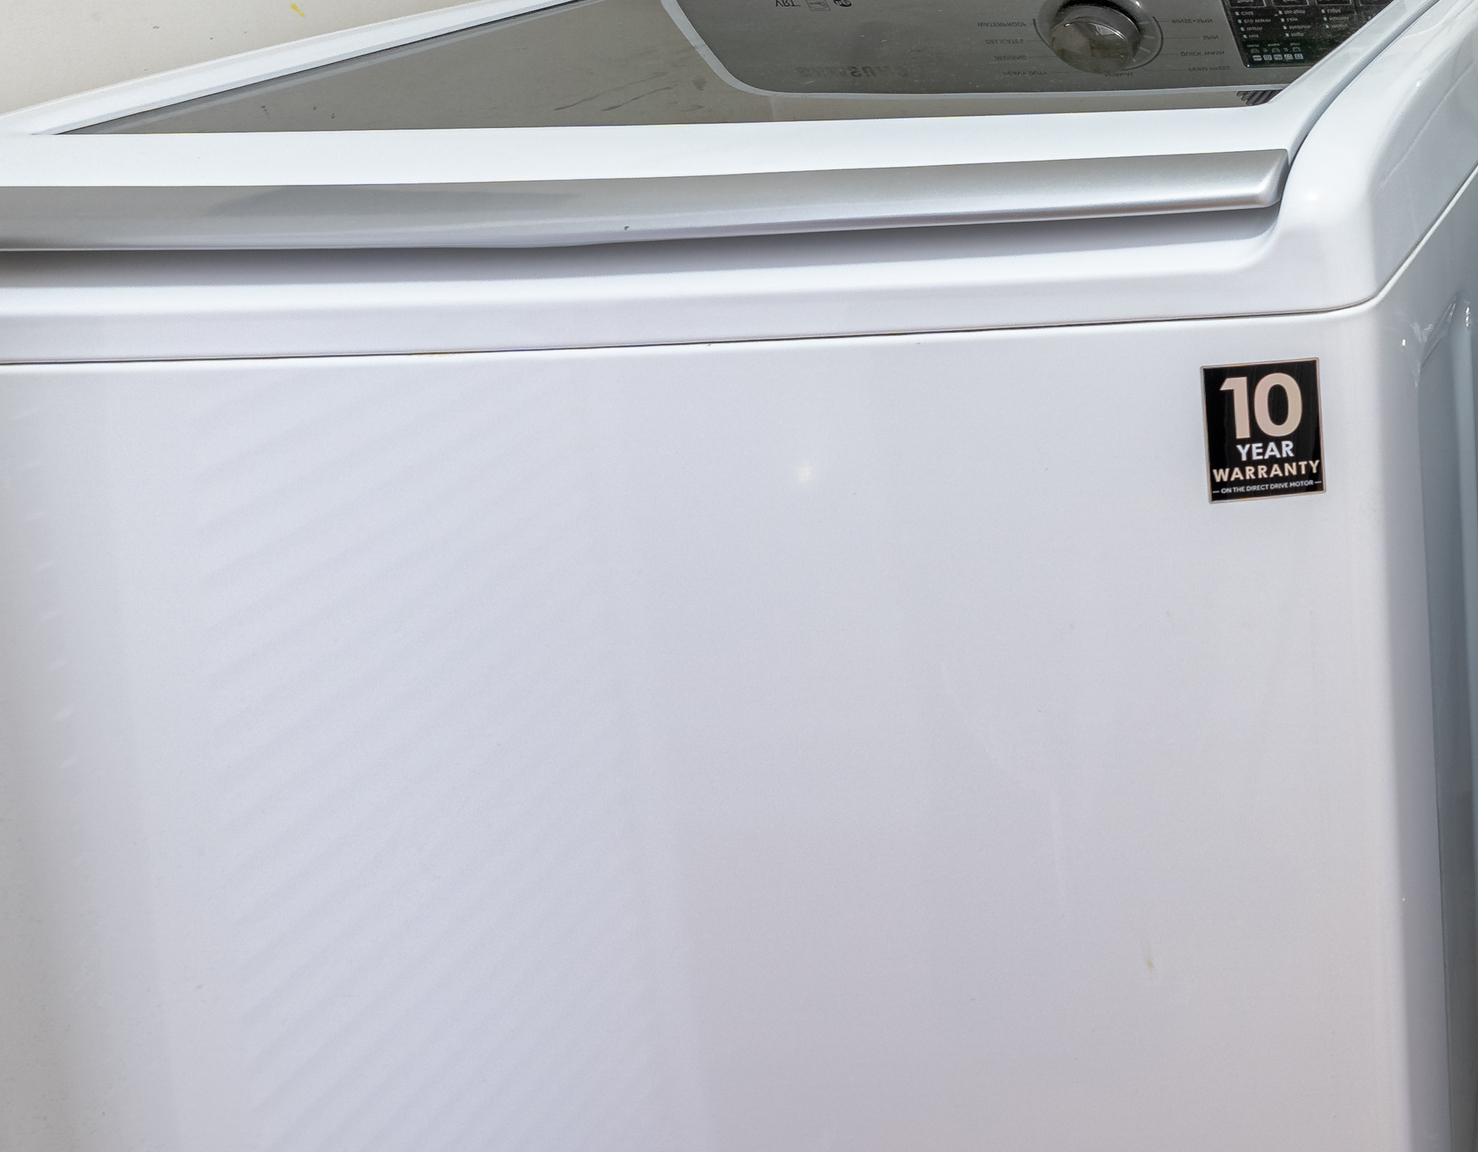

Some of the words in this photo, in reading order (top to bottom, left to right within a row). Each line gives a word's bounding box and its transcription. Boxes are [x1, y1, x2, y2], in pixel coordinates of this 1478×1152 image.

[1219, 372, 1303, 439] 10
[1236, 440, 1294, 461] YEAR
[1212, 460, 1320, 483] WARRANTY
[1233, 485, 1245, 493] THE
[1246, 484, 1269, 492] DIRECT
[1270, 482, 1289, 490] DRIVE
[1289, 479, 1314, 488] MOTOR
